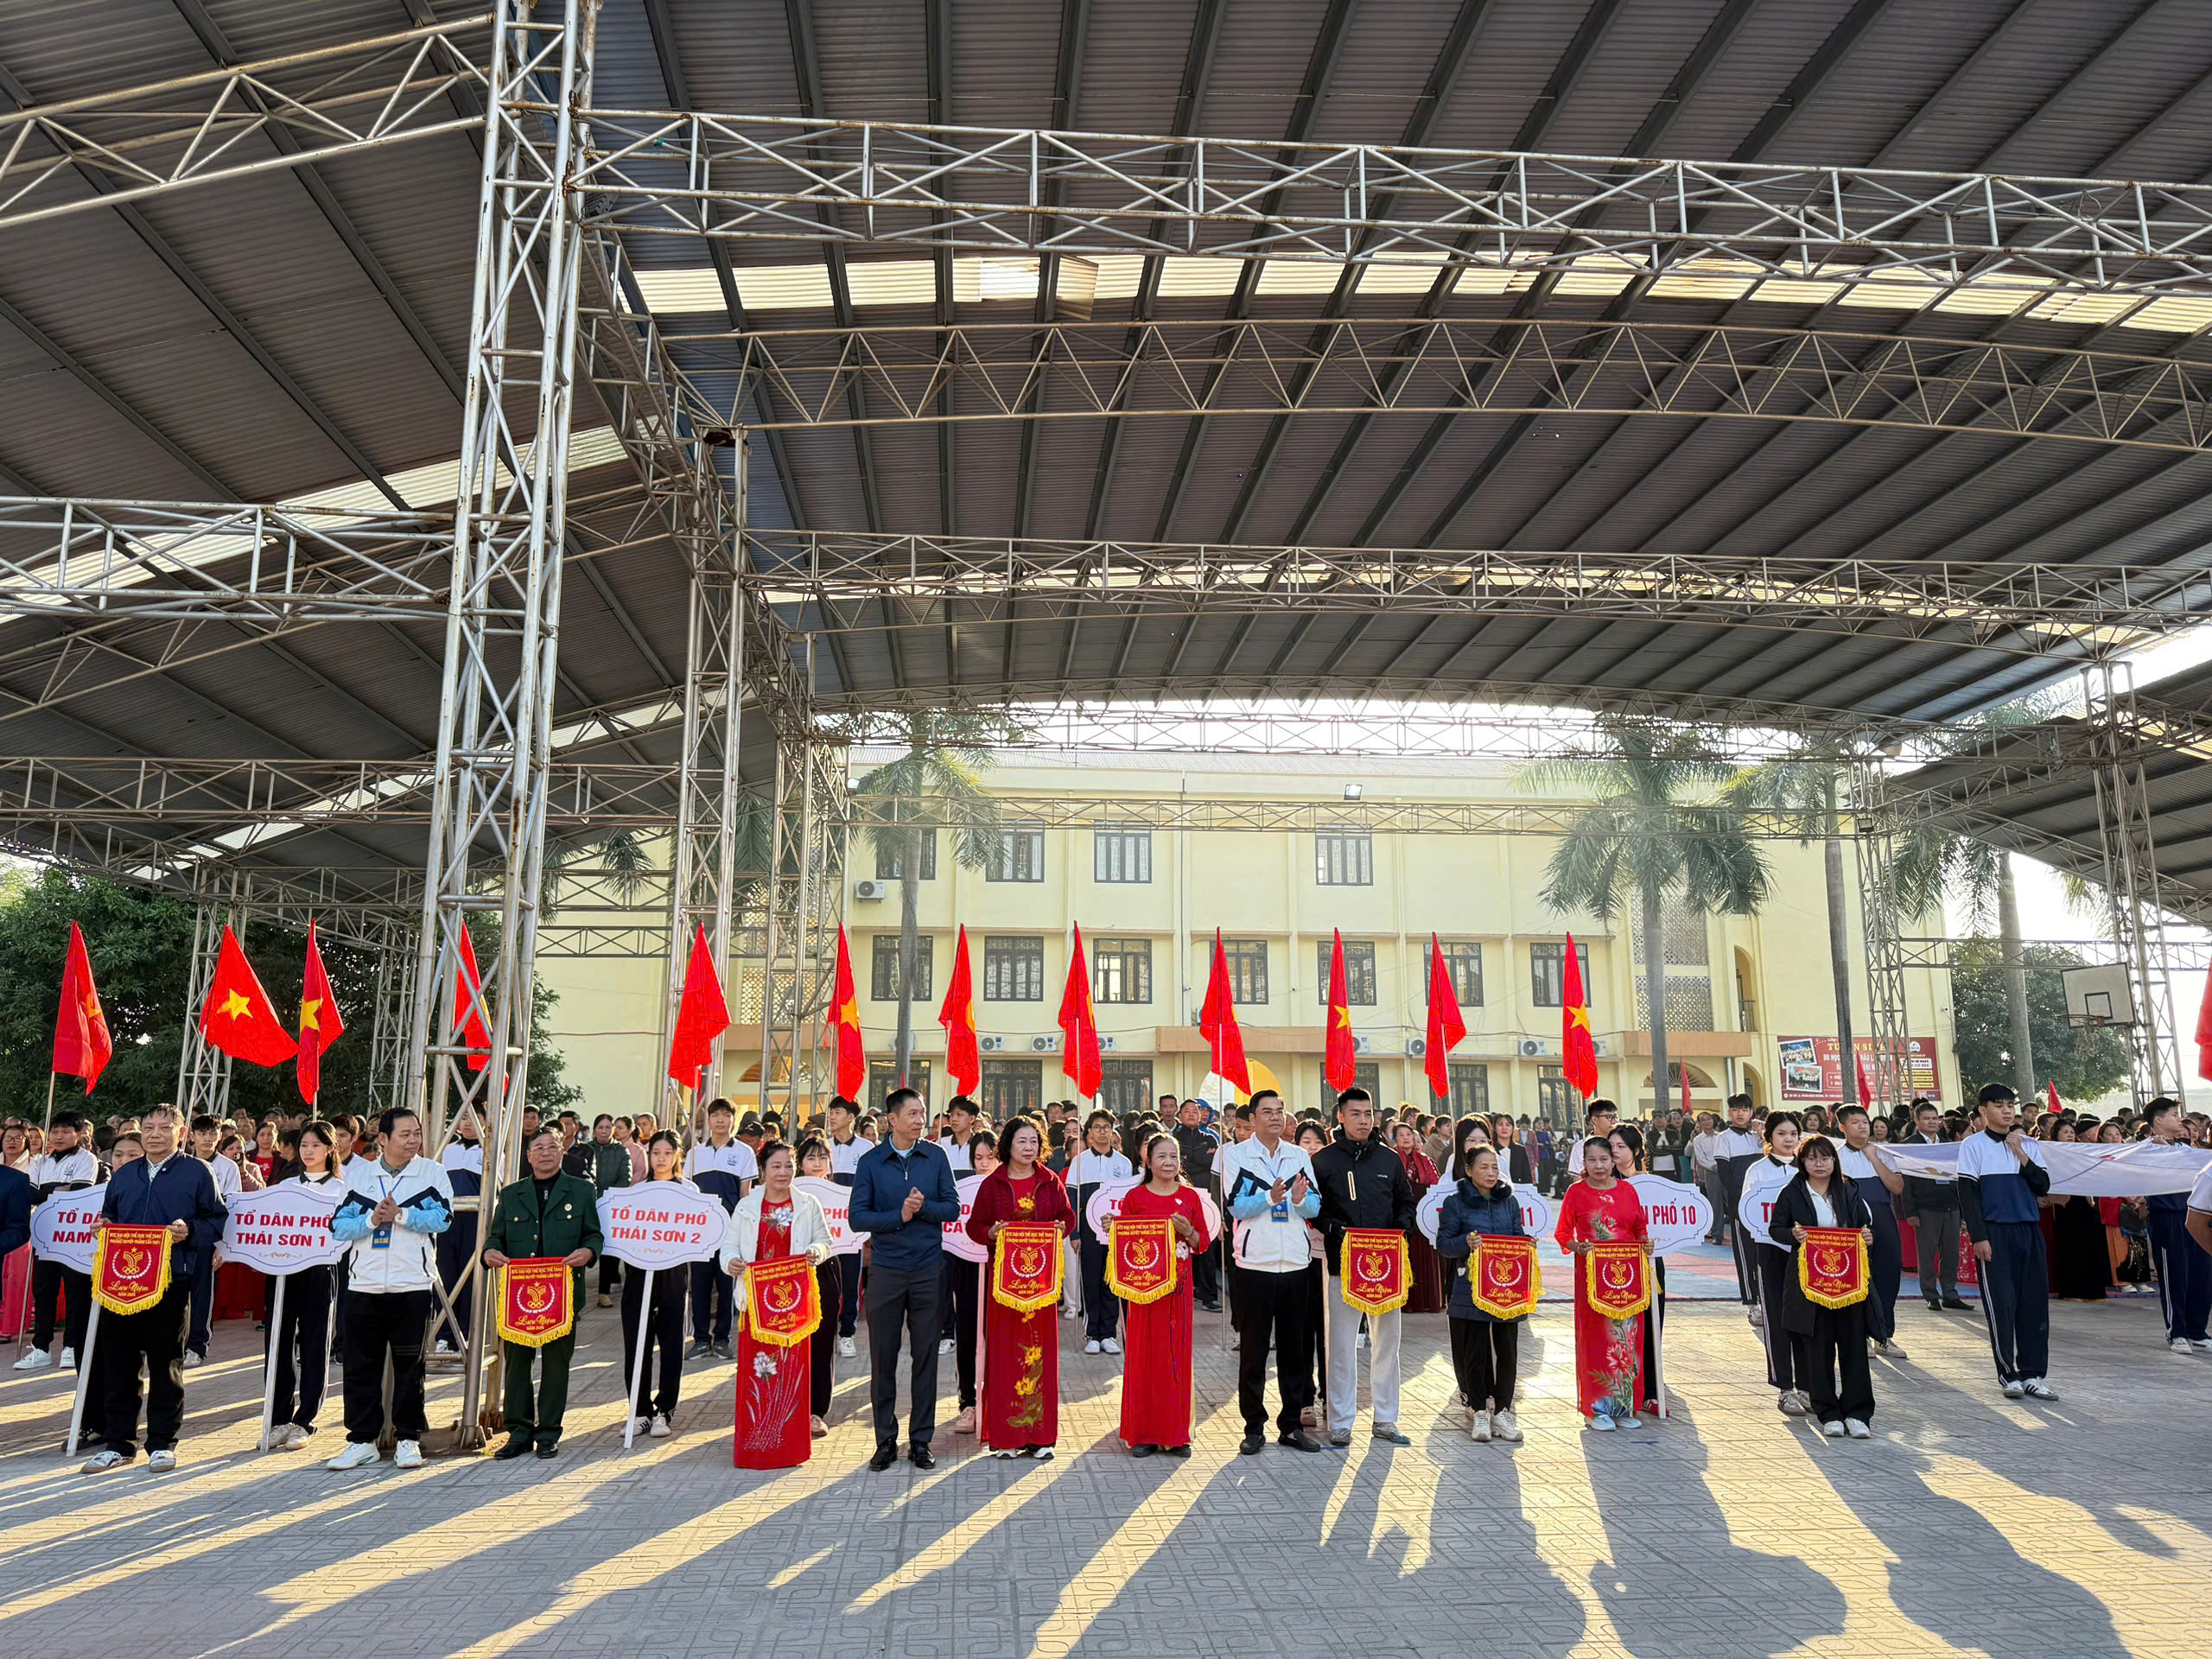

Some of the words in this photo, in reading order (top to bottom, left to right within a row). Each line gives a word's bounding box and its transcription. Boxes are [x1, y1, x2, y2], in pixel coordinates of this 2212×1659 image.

[58, 1207, 79, 1224] TỔ
[82, 1211, 103, 1224] DÂ
[235, 1210, 256, 1225] TỔ
[260, 1212, 294, 1227] DÂN
[611, 1205, 632, 1220] TỔ
[635, 1209, 670, 1223] DÂN
[674, 1210, 709, 1225] PHỐ
[1652, 1198, 1677, 1225] PHỐ
[1681, 1205, 1696, 1225] 10
[53, 1230, 92, 1244] NAM
[236, 1230, 272, 1245] THÁI
[277, 1234, 312, 1247] SƠN
[319, 1236, 325, 1248] 1
[611, 1226, 647, 1240] THÁI
[652, 1230, 686, 1243] SƠN
[690, 1232, 702, 1244] 2
